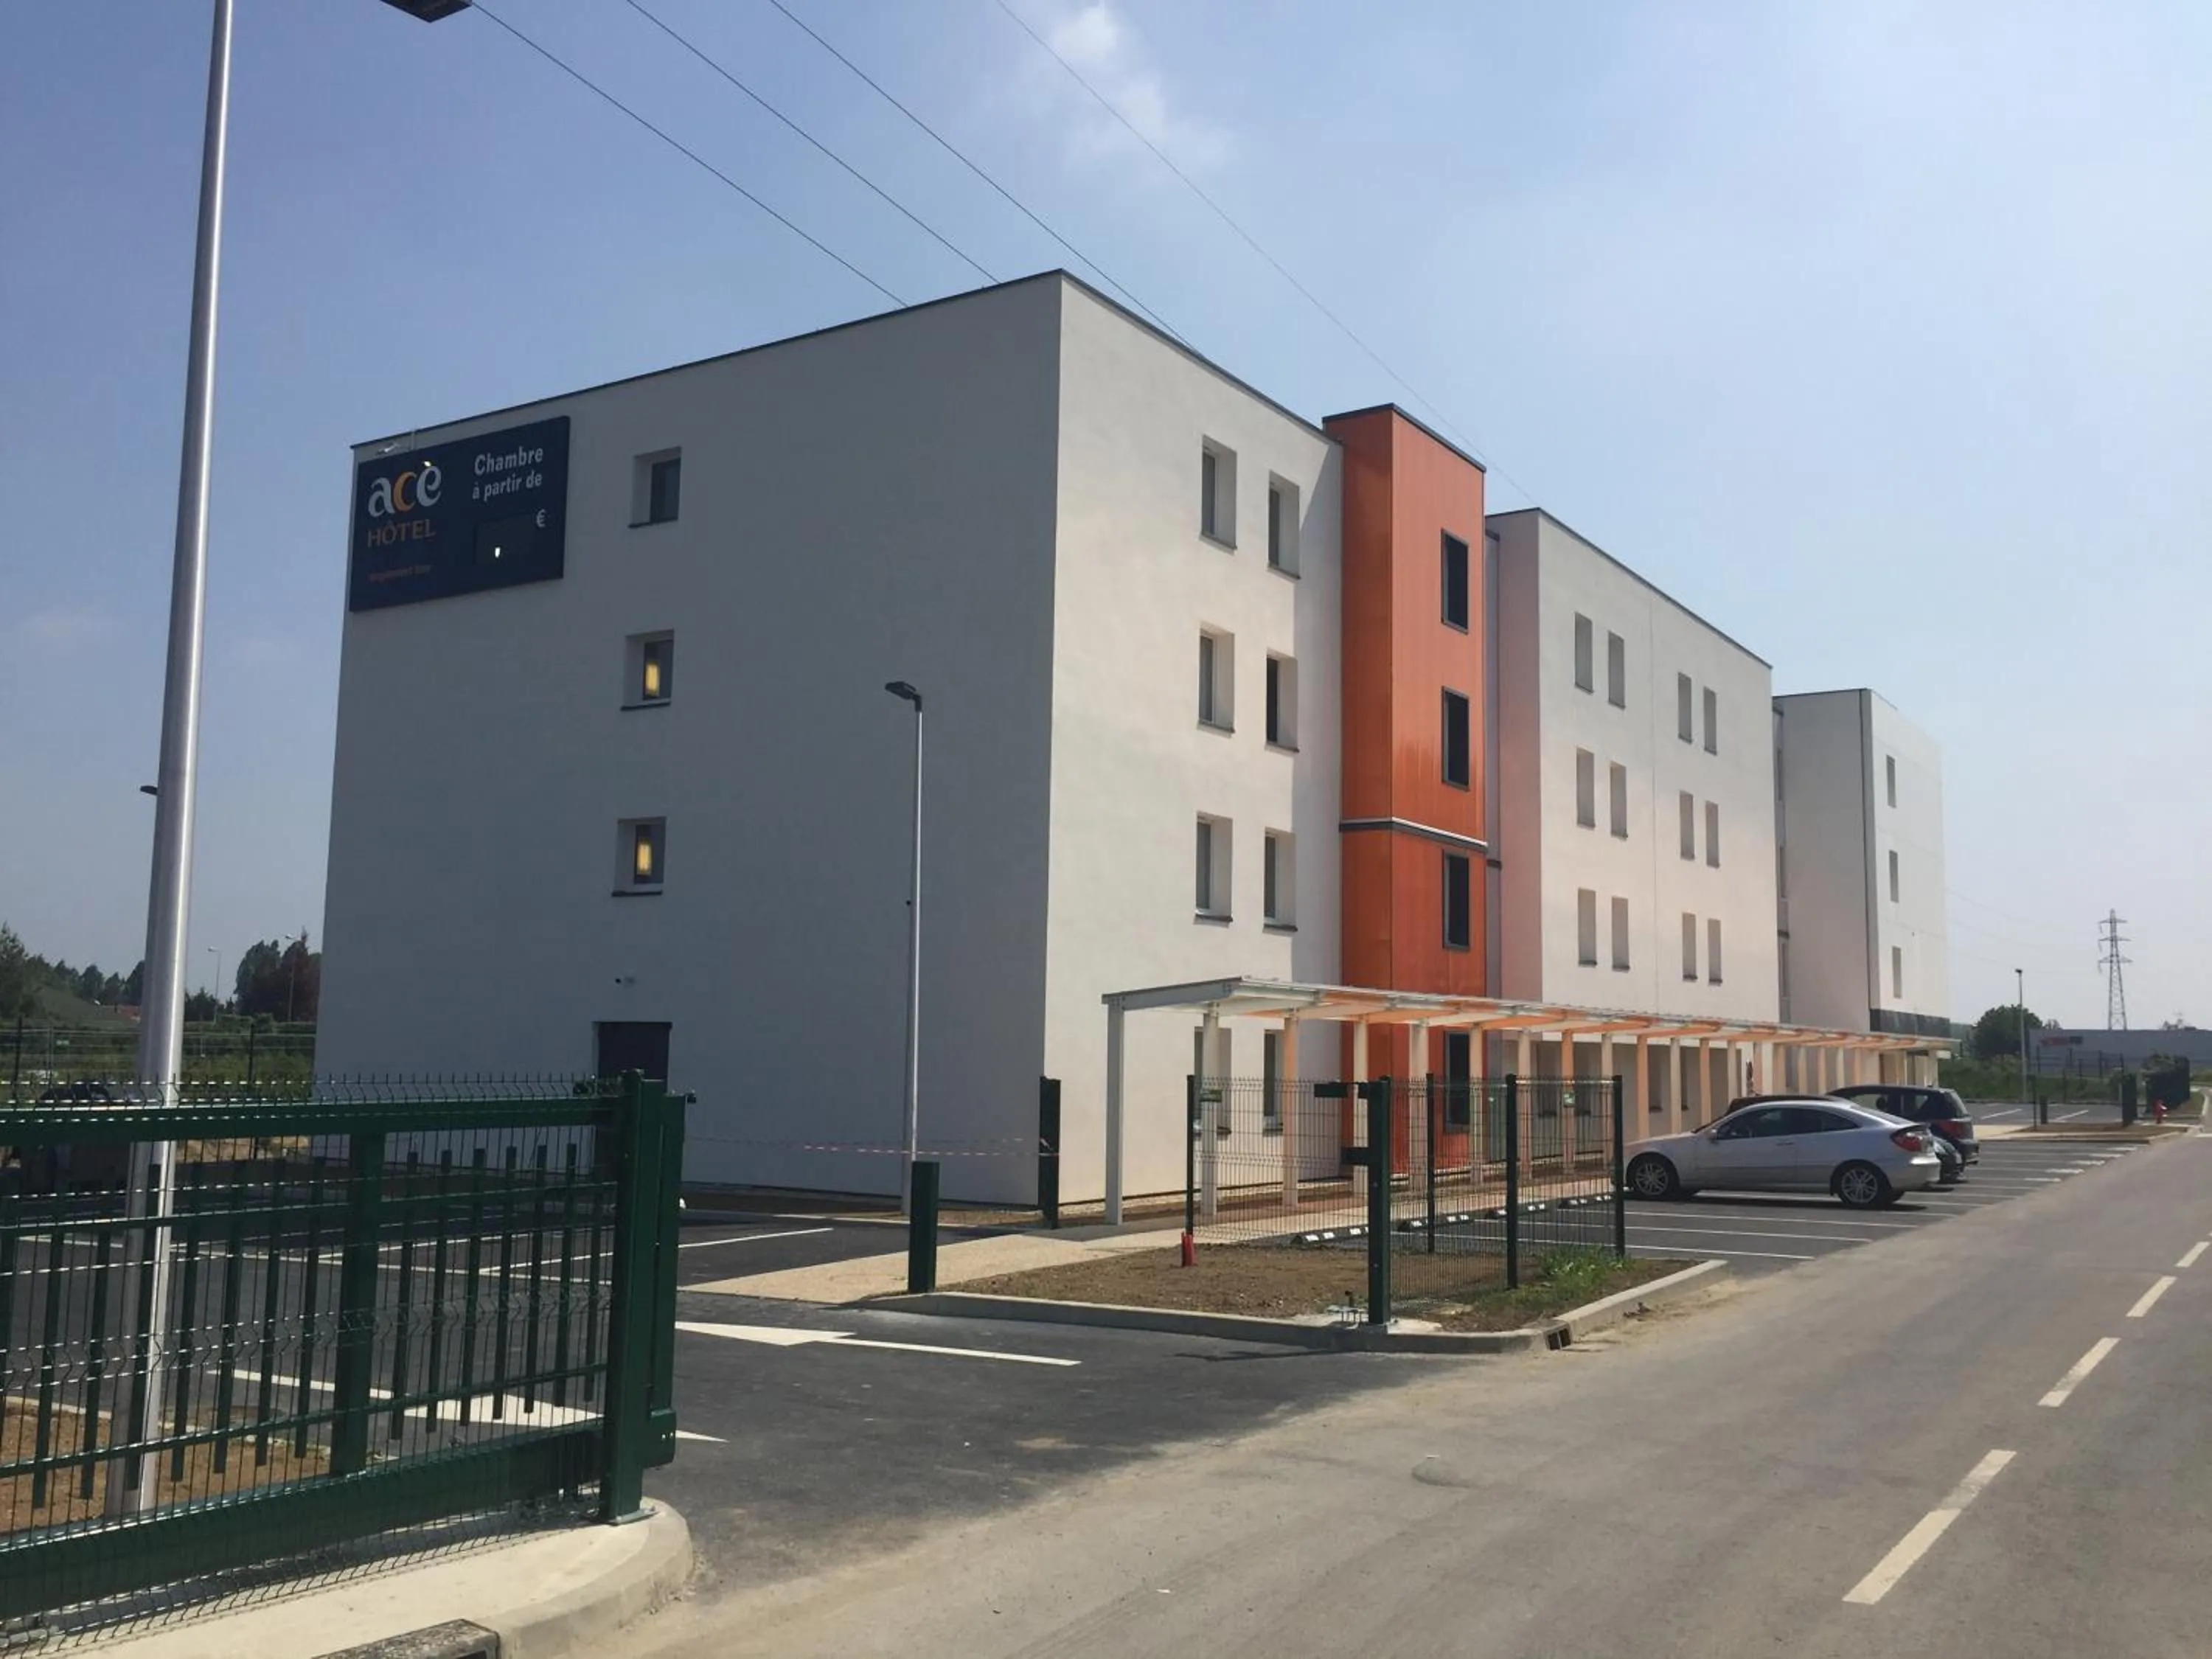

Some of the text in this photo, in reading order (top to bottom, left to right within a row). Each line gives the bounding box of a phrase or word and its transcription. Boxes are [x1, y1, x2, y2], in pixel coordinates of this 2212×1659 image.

[475, 446, 543, 476] Chambre
[473, 470, 543, 502] à partir de
[536, 509, 546, 527] €
[368, 519, 436, 547] HÔTEL
